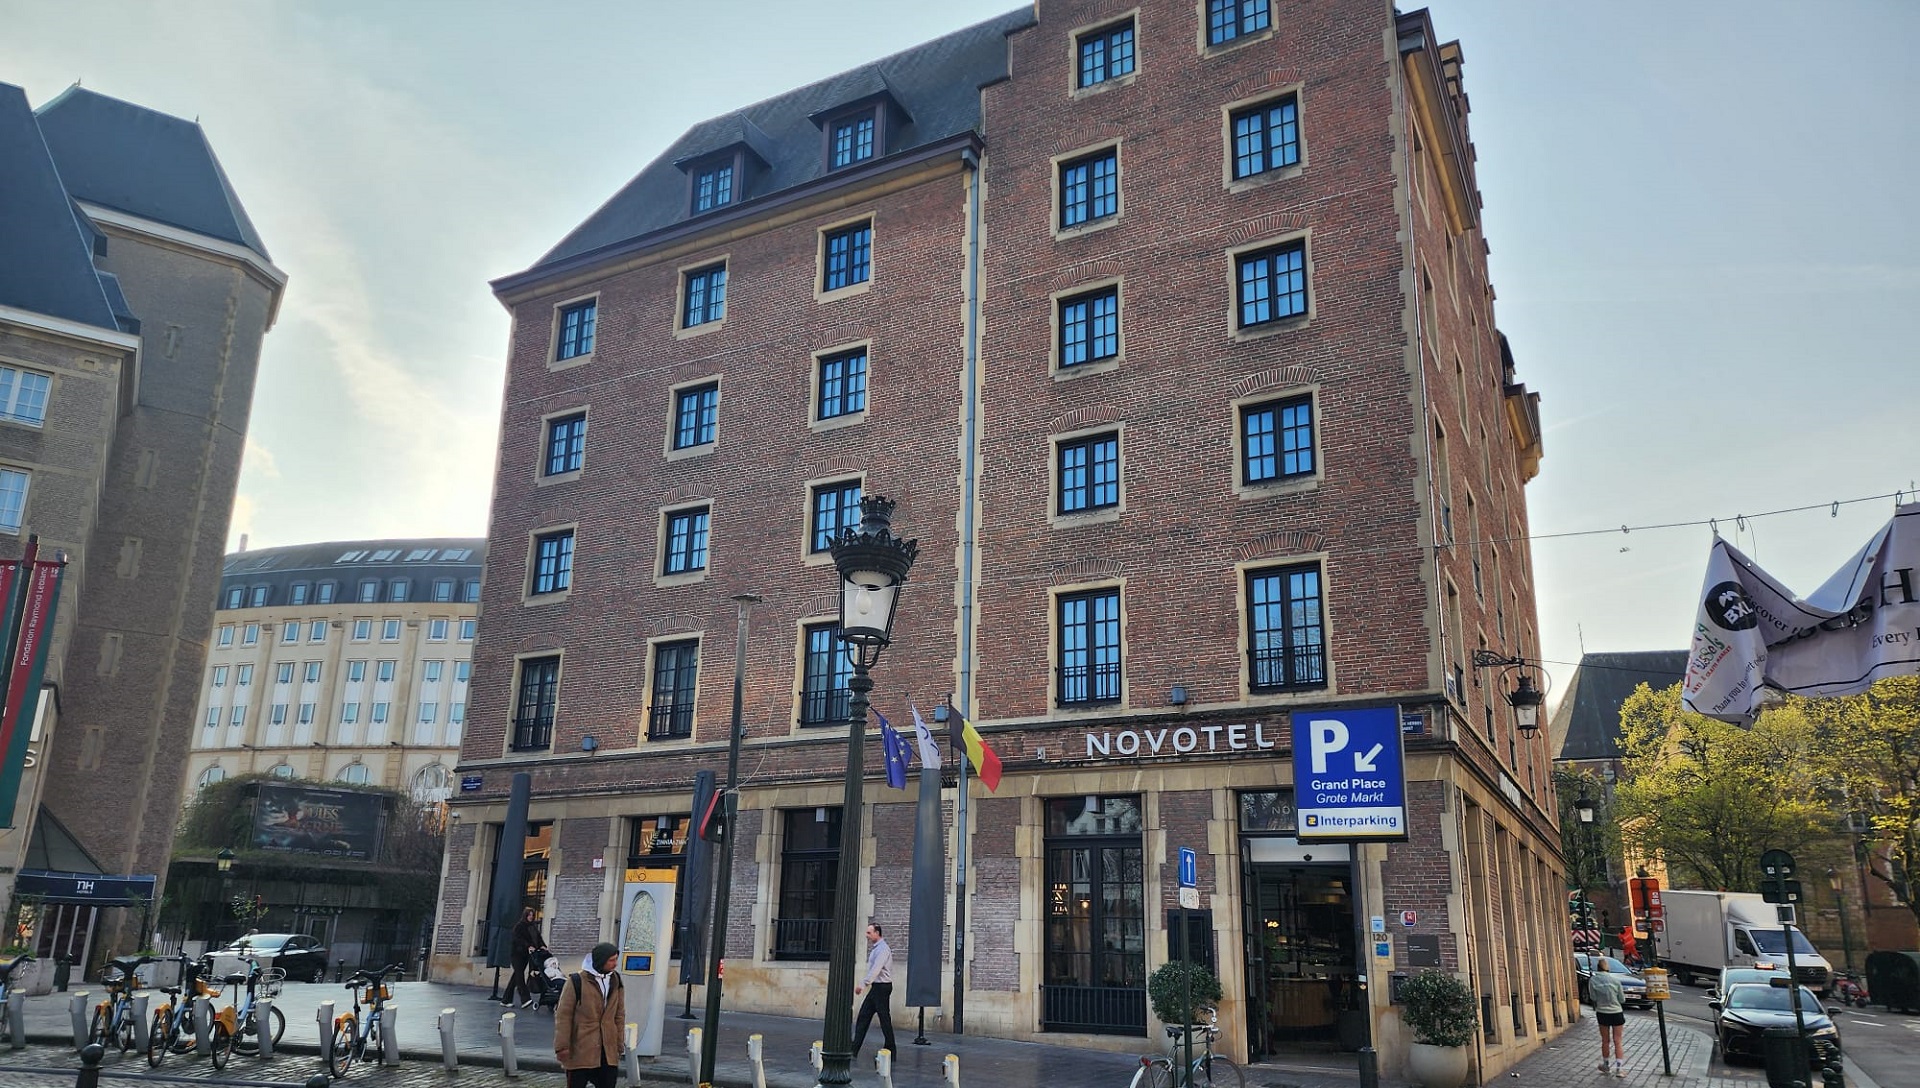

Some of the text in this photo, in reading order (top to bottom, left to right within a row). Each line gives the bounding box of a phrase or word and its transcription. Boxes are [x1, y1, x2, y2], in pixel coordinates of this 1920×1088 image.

[20, 566, 48, 666] Fondation Raymond Leblanc
[1722, 601, 1754, 625] BXL
[1872, 632, 1911, 648] Every
[1712, 695, 1731, 715] Thank
[1729, 684, 1741, 702] you
[1087, 723, 1275, 756] NOVOTEL
[1310, 719, 1350, 774] P
[1311, 778, 1386, 791] Grand Place
[1316, 792, 1384, 804] Grote Markt
[1321, 815, 1397, 828] Interparking
